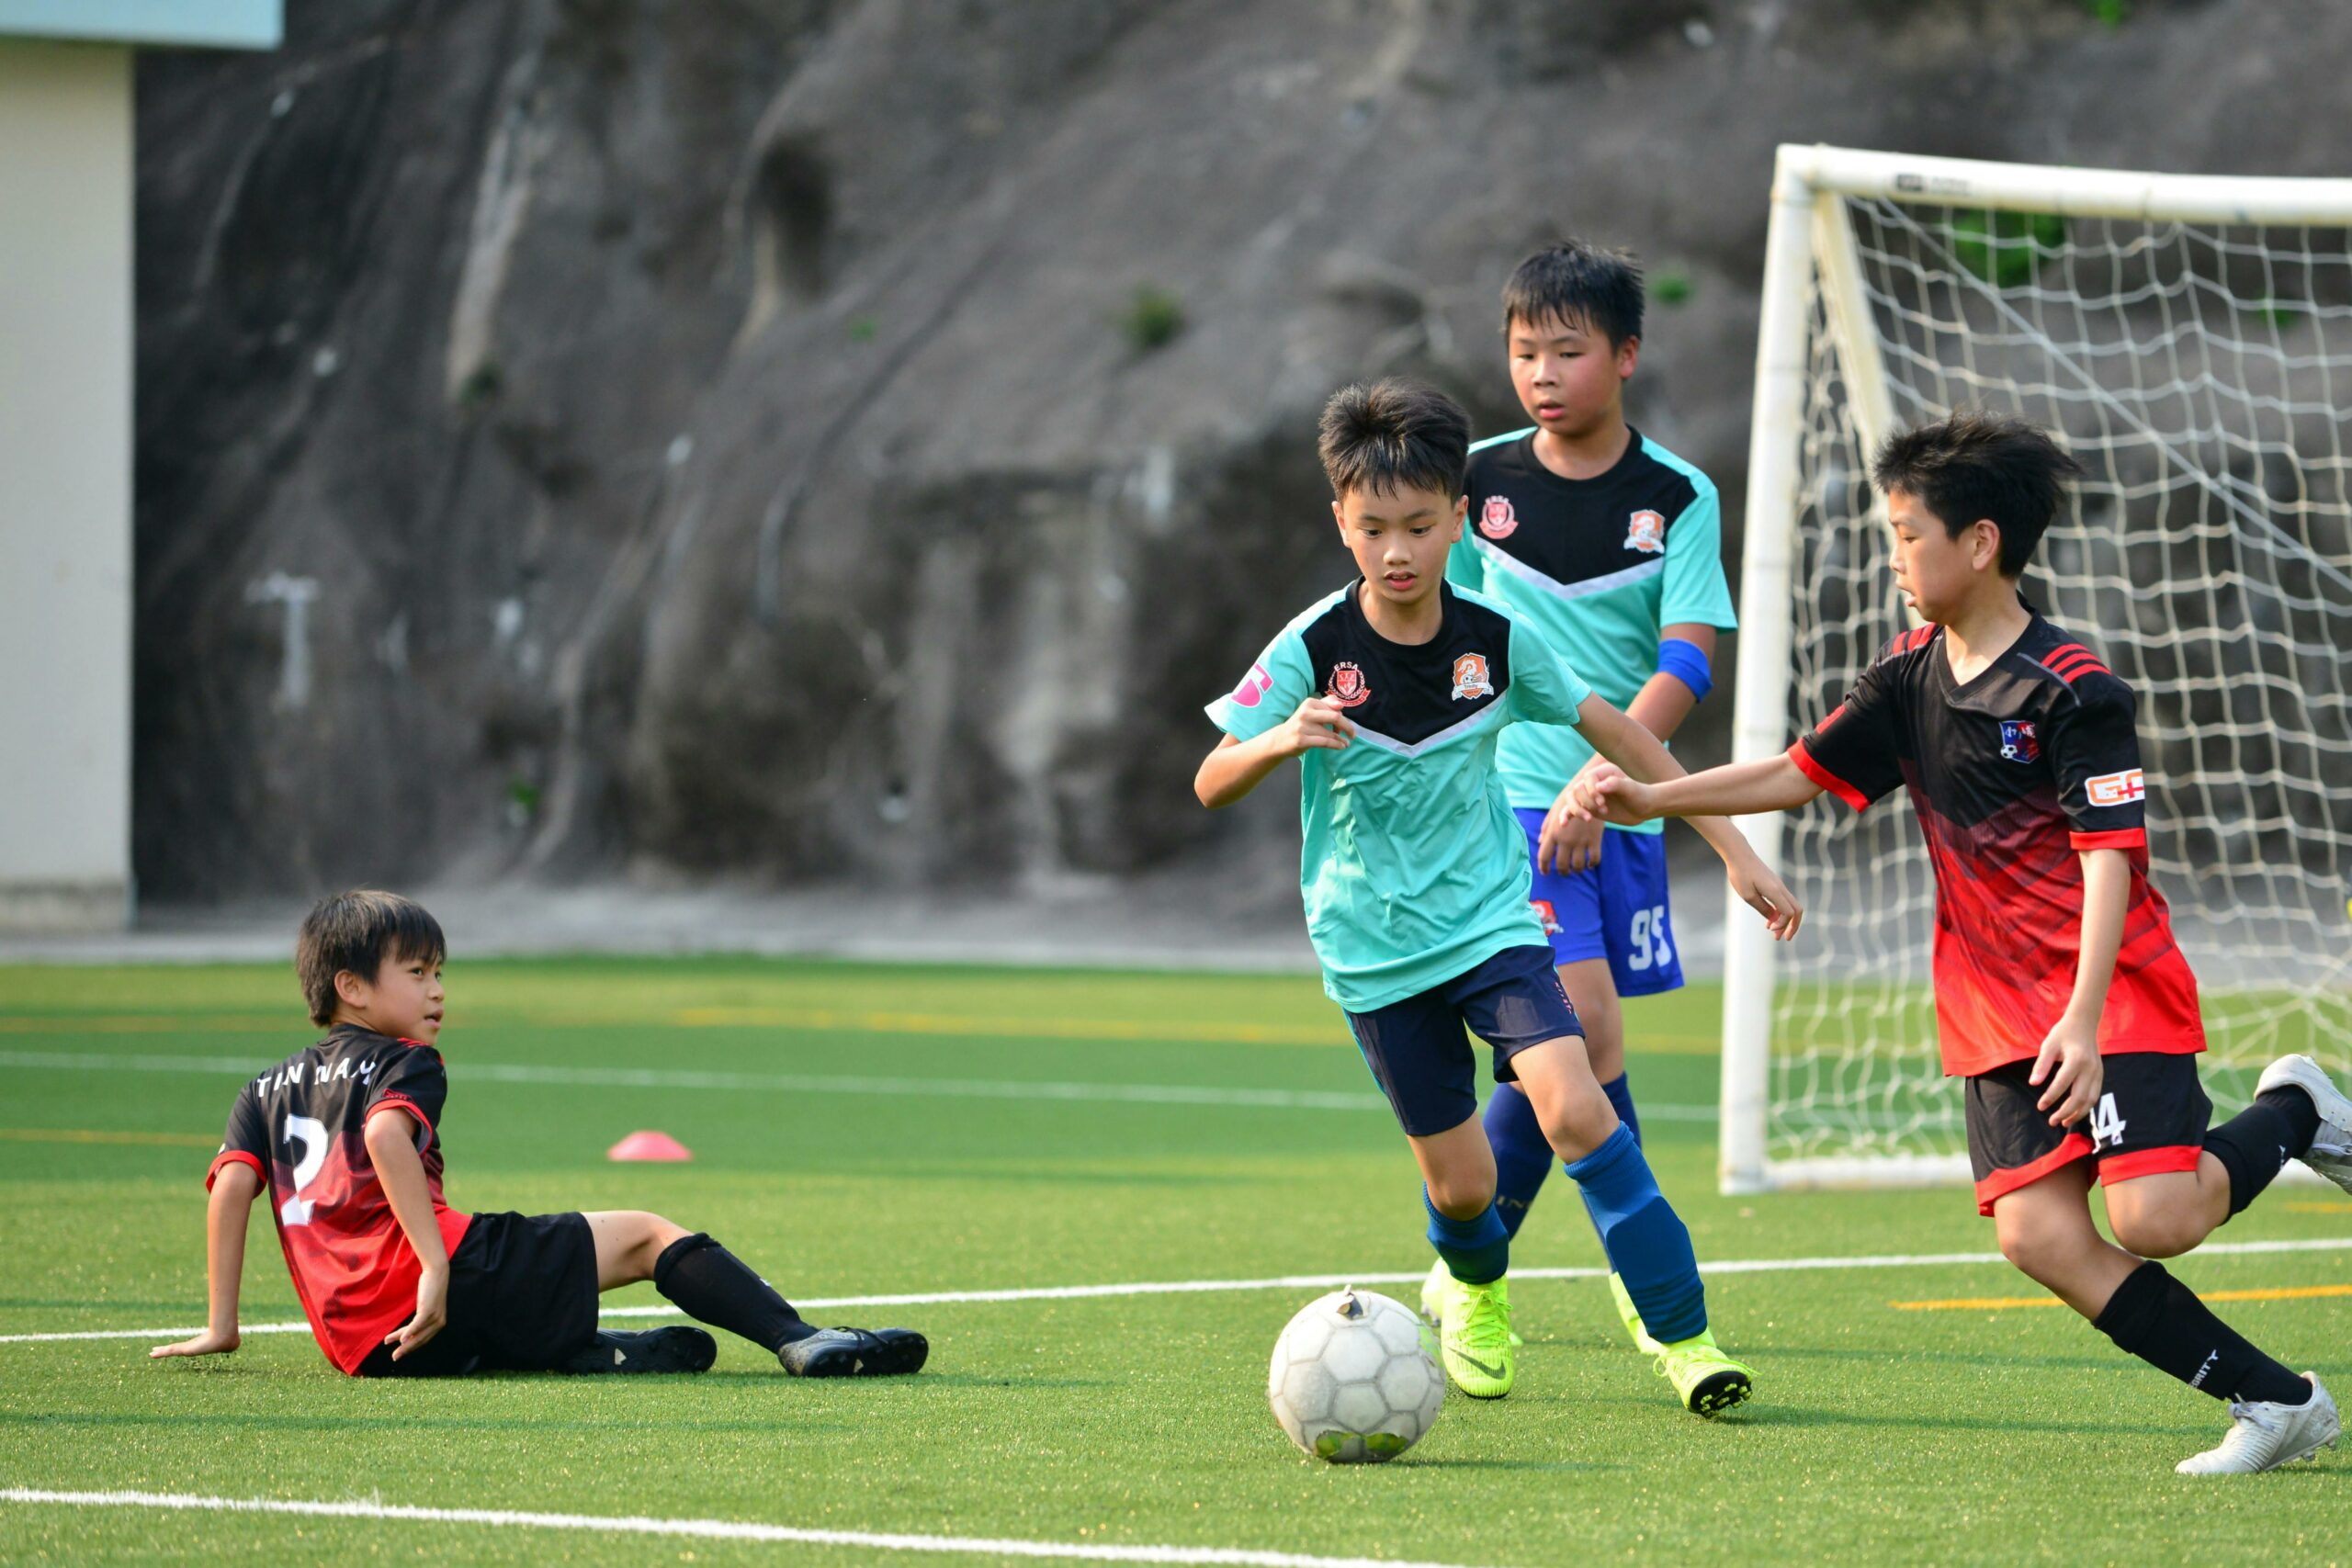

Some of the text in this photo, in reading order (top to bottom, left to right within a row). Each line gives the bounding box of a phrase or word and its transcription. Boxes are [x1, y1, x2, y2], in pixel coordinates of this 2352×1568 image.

[1333, 660, 1359, 672] ERSA
[1628, 905, 1672, 971] 95
[257, 1062, 305, 1098] TIN
[280, 1112, 329, 1226] 2
